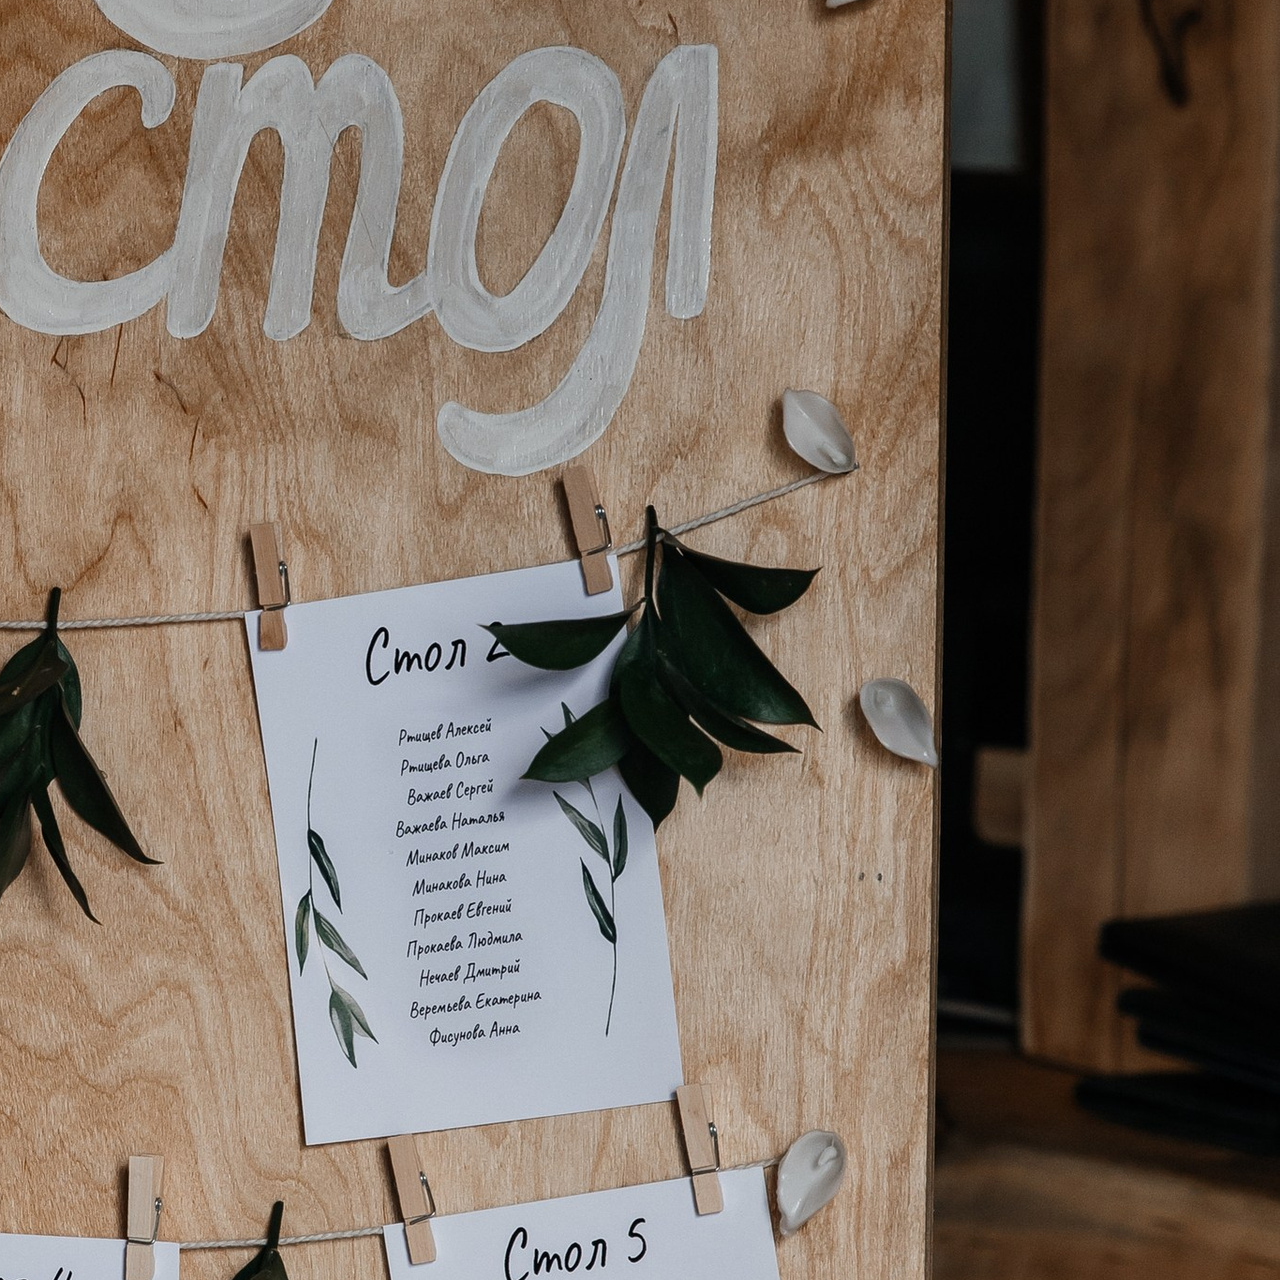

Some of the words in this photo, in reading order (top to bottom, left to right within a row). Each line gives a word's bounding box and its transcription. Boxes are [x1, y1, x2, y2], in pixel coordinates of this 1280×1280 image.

[366, 627, 466, 685] Стол
[398, 723, 444, 746] Ртищев
[445, 718, 492, 739] Алексей
[400, 753, 452, 776] Ртищева
[455, 751, 490, 769] Ольга
[407, 783, 454, 806] Важаев
[456, 778, 493, 801] Сергей
[396, 815, 448, 838] Важаева
[452, 811, 505, 831] Наталья
[406, 843, 459, 867] Минаков
[461, 841, 509, 859] Максим
[412, 873, 472, 897] Минакова
[476, 870, 507, 888] Нина
[414, 903, 464, 929] Прокаев
[466, 898, 512, 919] Евгений
[407, 935, 463, 960] Прокаева
[467, 930, 523, 949] Людмила
[419, 965, 461, 988] Нечаев
[463, 959, 520, 984] Дмитрий
[410, 995, 472, 1020] Веремьева
[475, 991, 542, 1009] Екатерина
[429, 1023, 486, 1047] Фисунова
[489, 1021, 521, 1039] Анна
[628, 1218, 647, 1263] 5
